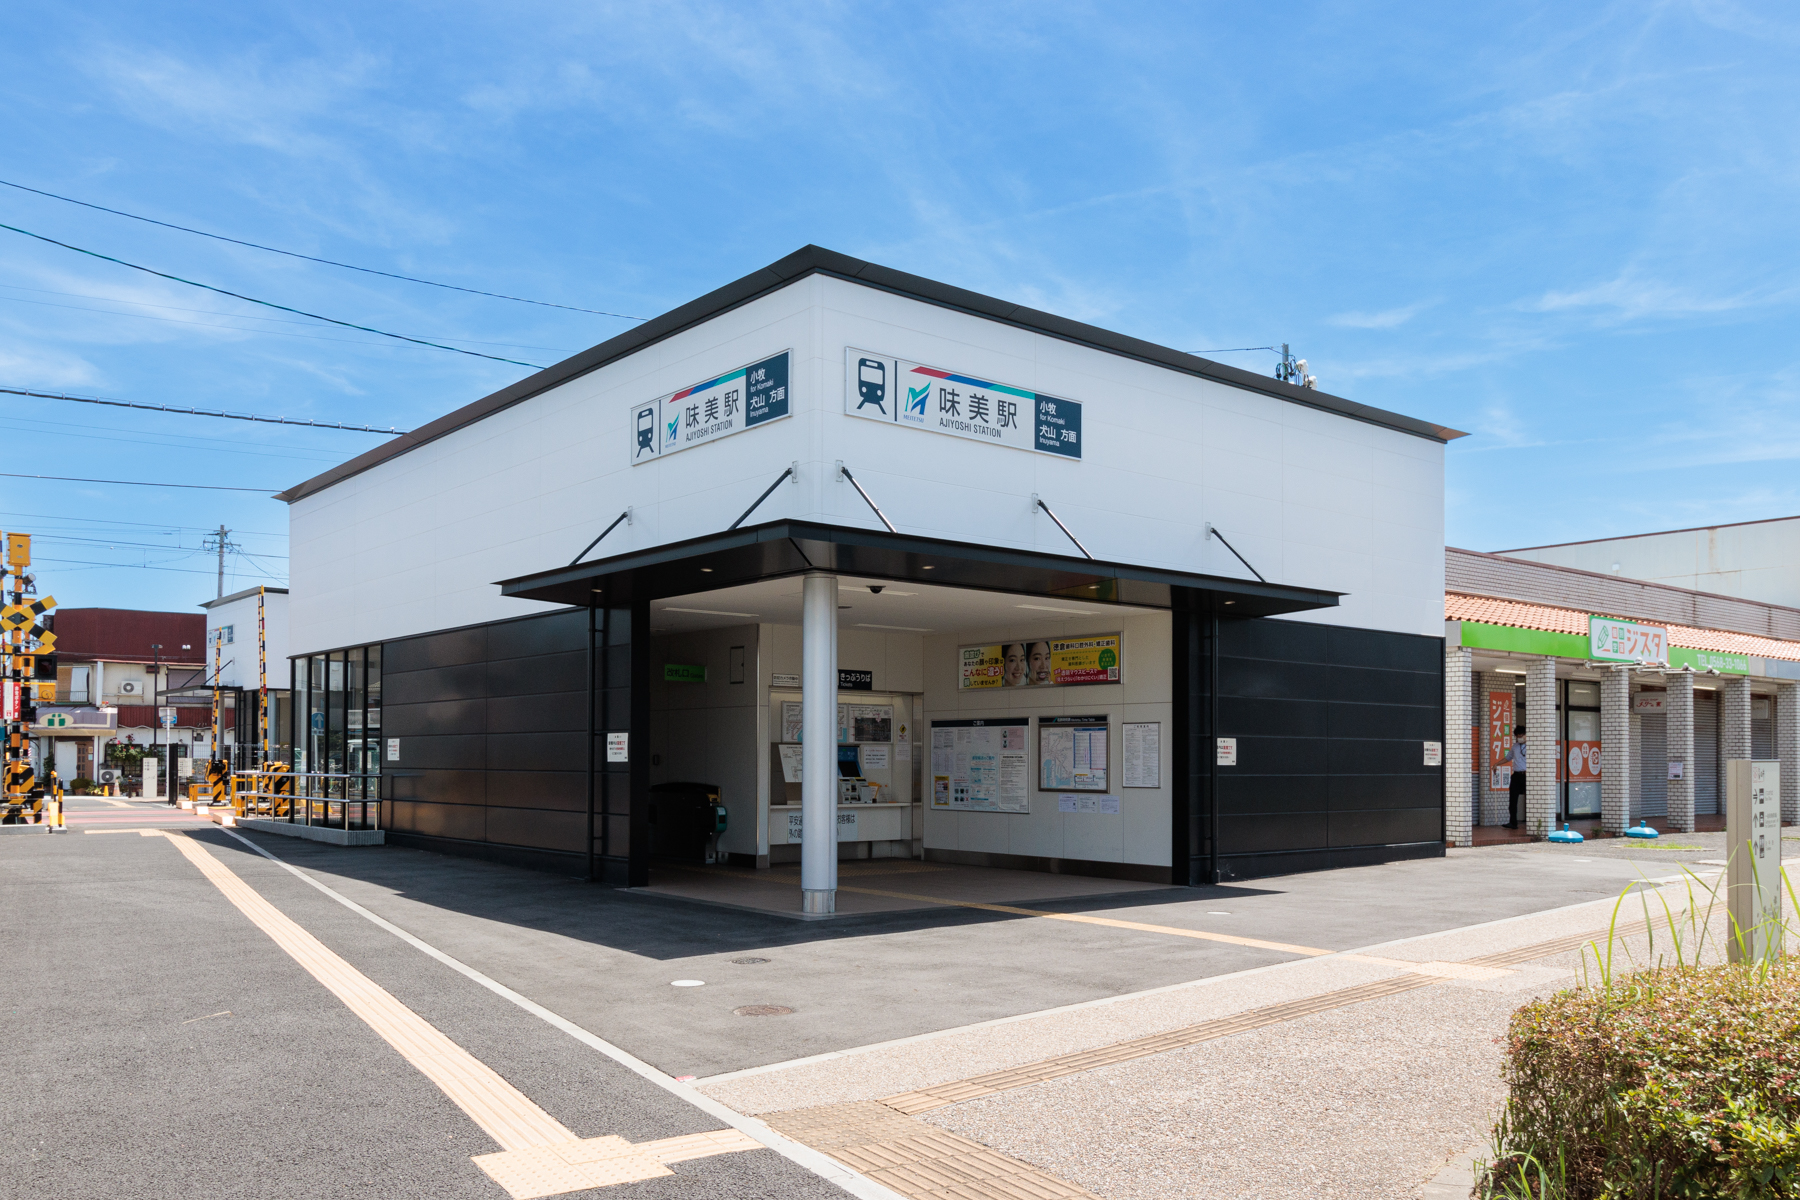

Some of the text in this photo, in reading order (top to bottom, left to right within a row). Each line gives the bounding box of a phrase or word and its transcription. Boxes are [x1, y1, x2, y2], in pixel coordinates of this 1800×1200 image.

[750, 367, 766, 384] 小牧
[757, 378, 774, 391] Komaki
[750, 386, 786, 410] 犬山 方面
[685, 389, 739, 429] 味美駅
[750, 406, 769, 418] Inuyama
[939, 387, 1018, 430] 味美駅
[1039, 400, 1057, 416] 小牧
[903, 414, 925, 424] MEITETSU
[1039, 413, 1066, 426] for Komaki
[685, 418, 733, 443] AJIYOSHI STATION
[939, 417, 1002, 439] AJIYOSHI STATION
[1039, 424, 1077, 444] 犬山 方面
[1039, 436, 1060, 447] Inuyama
[1626, 628, 1662, 658] ジスタ
[963, 657, 1004, 667] あなたの顔や印象は
[666, 668, 690, 678] 改札口
[840, 672, 871, 682] きっぷうりば
[1492, 699, 1503, 760] ジスタ
